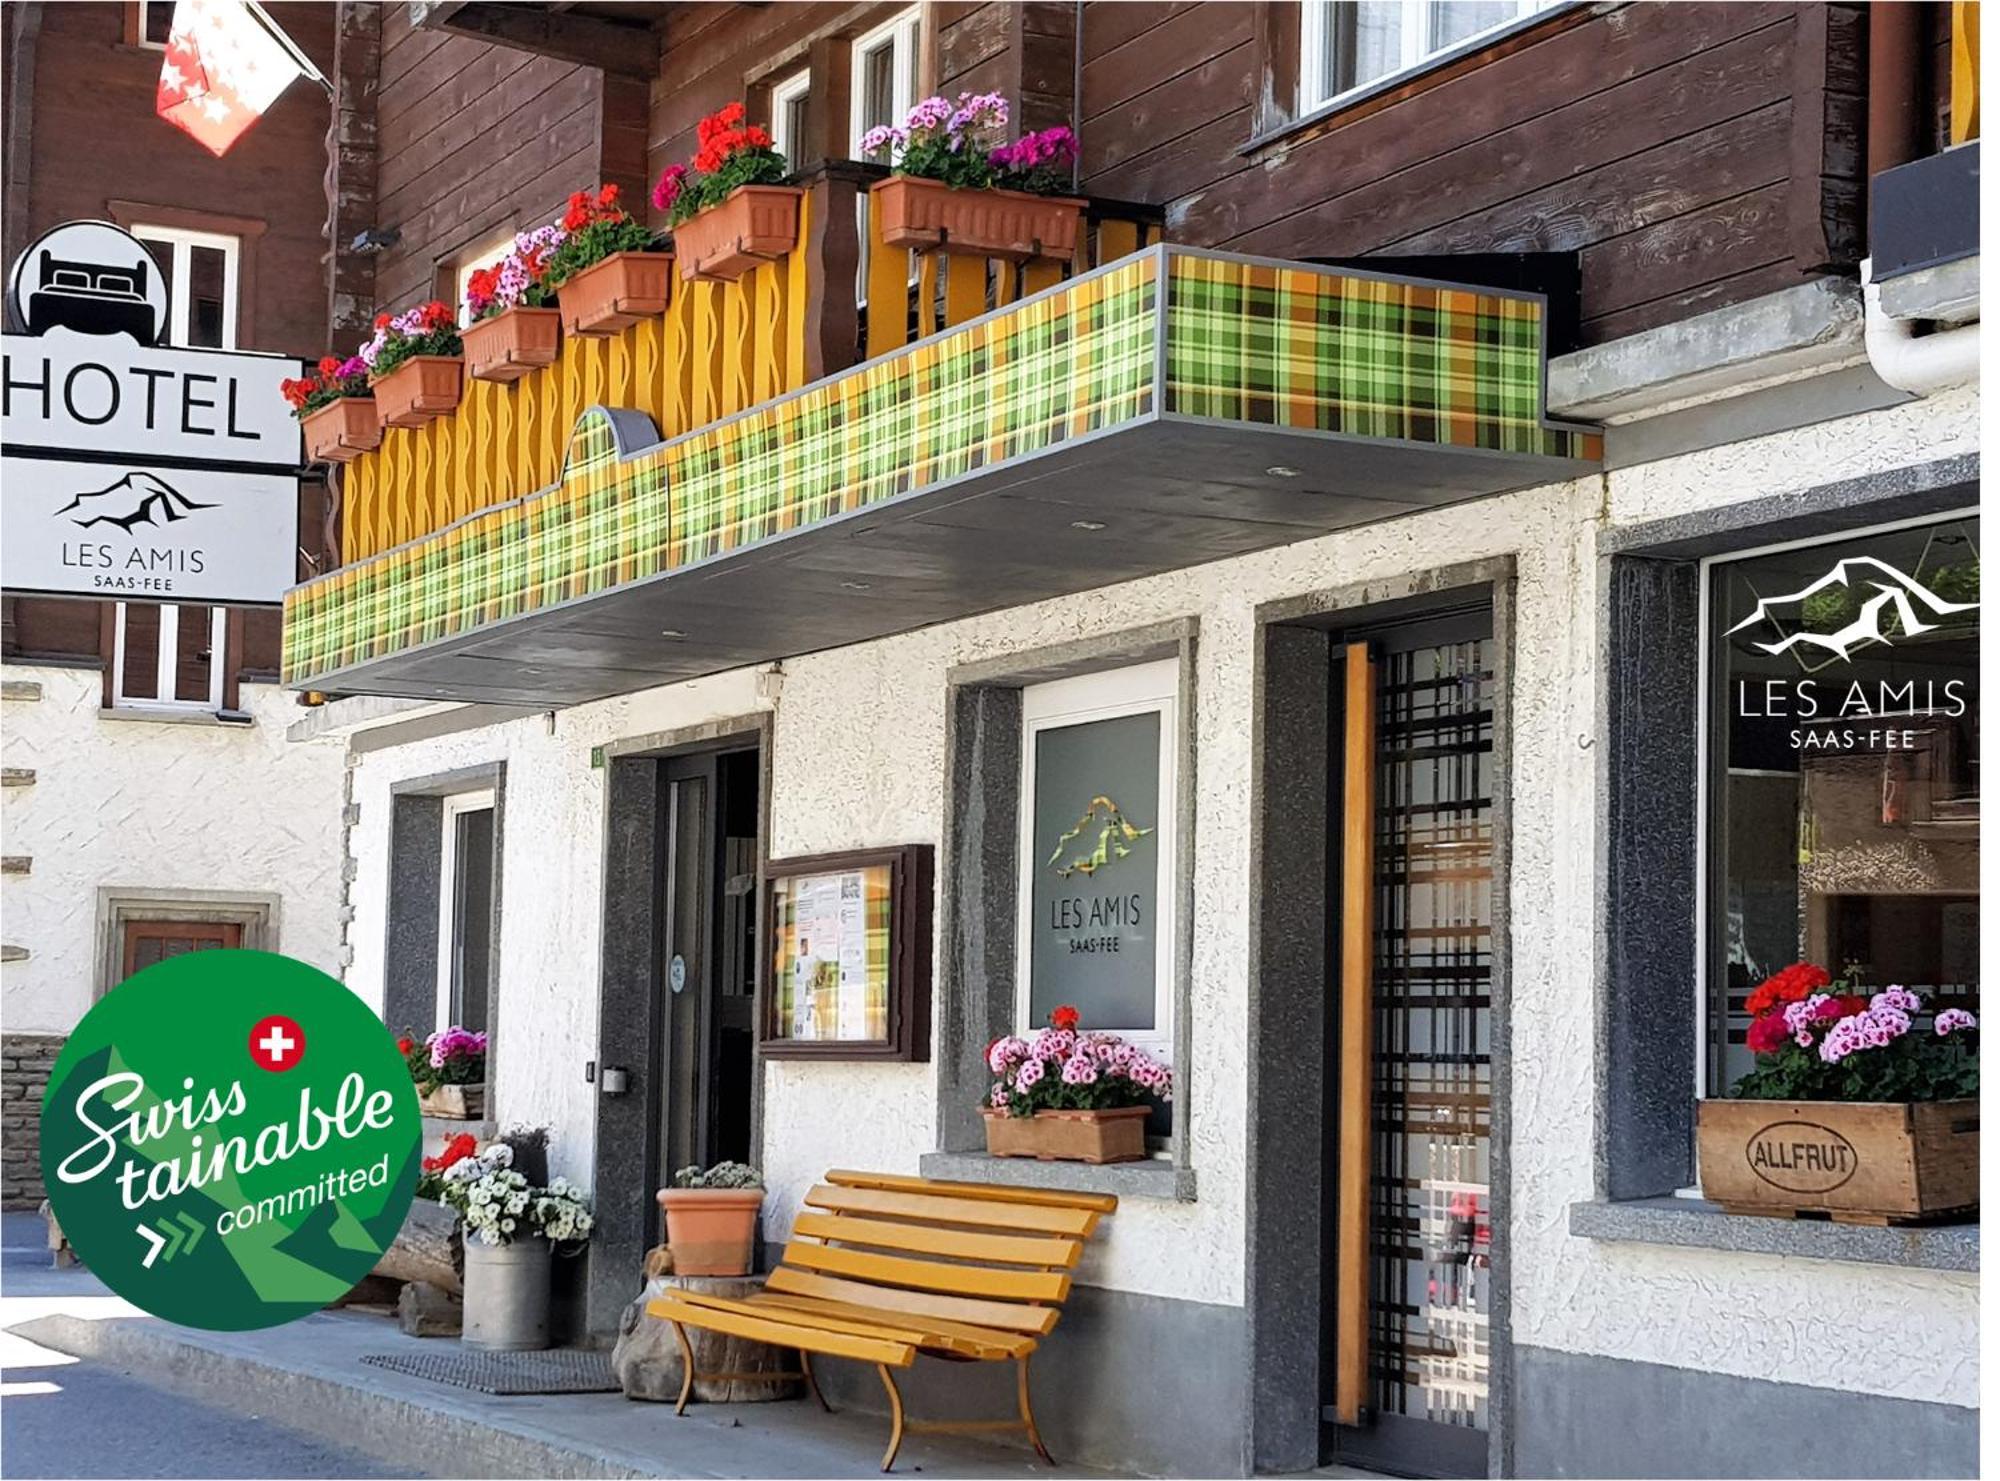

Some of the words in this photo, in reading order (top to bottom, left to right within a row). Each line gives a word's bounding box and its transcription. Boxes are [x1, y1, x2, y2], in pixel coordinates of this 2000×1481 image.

[3, 355, 261, 440] HOTEL
[62, 543, 113, 569] LES
[125, 547, 204, 573] AMIS
[93, 576, 172, 591] SAAS-FEE
[1051, 898, 1082, 930] LES
[1089, 894, 1140, 926] AMIS
[1069, 937, 1120, 954] SAAS-FEE
[1754, 1141, 1848, 1173] ALLFRUT
